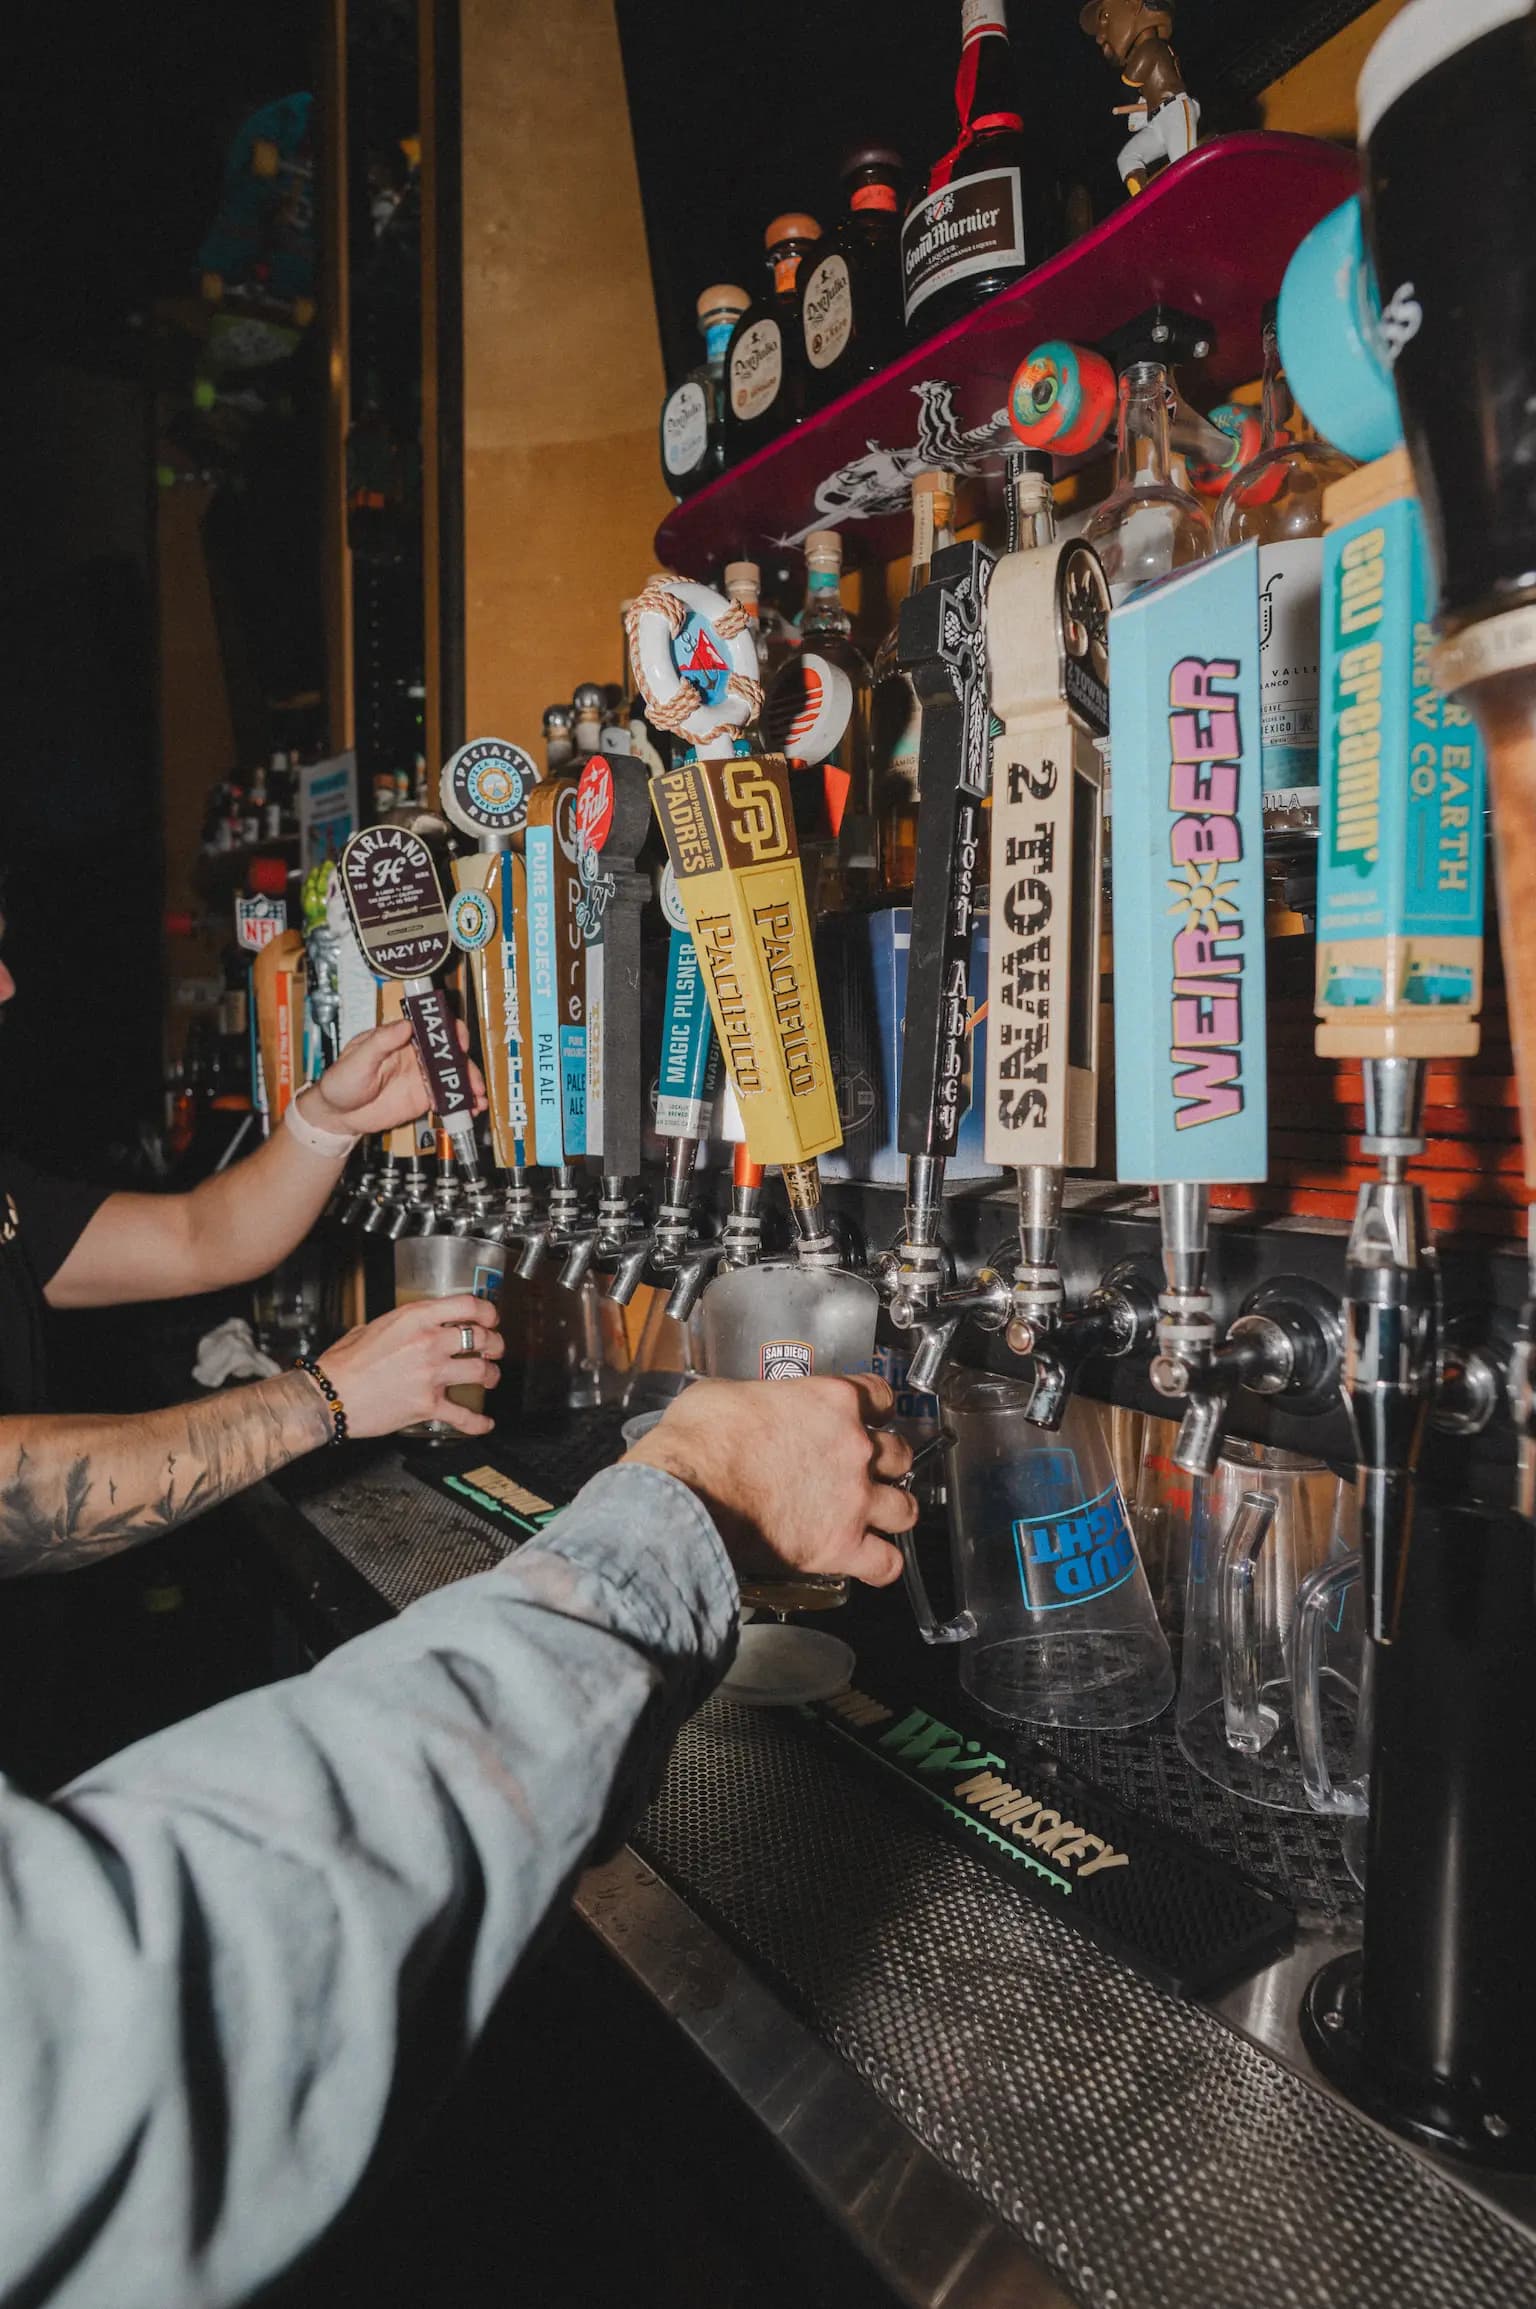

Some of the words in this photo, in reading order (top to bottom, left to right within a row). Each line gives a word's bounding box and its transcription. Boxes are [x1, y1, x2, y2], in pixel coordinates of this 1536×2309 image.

[931, 208, 1000, 248] Marnier
[1260, 679, 1289, 690] LANCO
[455, 745, 532, 787] SPECIALTY
[684, 770, 698, 800] PROUD
[1007, 759, 1058, 804] 2
[661, 774, 706, 874] PADRES
[1438, 745, 1473, 891] EARTH
[348, 830, 428, 878] HARLAND
[532, 841, 549, 897] PURE
[701, 839, 710, 851] OF
[704, 851, 716, 868] THE
[375, 943, 416, 963] HAZY
[419, 937, 444, 954] IPA
[534, 902, 551, 998] PROJECT
[500, 941, 524, 1045] PIZZA
[673, 943, 699, 1018] PILSNER
[752, 901, 817, 1097] PACIFICO
[999, 822, 1056, 1131] TOWNS
[695, 913, 765, 1100] PACIFICO
[418, 996, 454, 1061] HAZY
[438, 1067, 465, 1110] IPA
[538, 1033, 554, 1072] PALE
[665, 1024, 690, 1084] MAGIC
[539, 1076, 555, 1106] ALE
[569, 1097, 585, 1116] ALE
[764, 1346, 783, 1360] SAN
[783, 1345, 809, 1361] DIEGO
[954, 1770, 1130, 1877] WHISKEY
